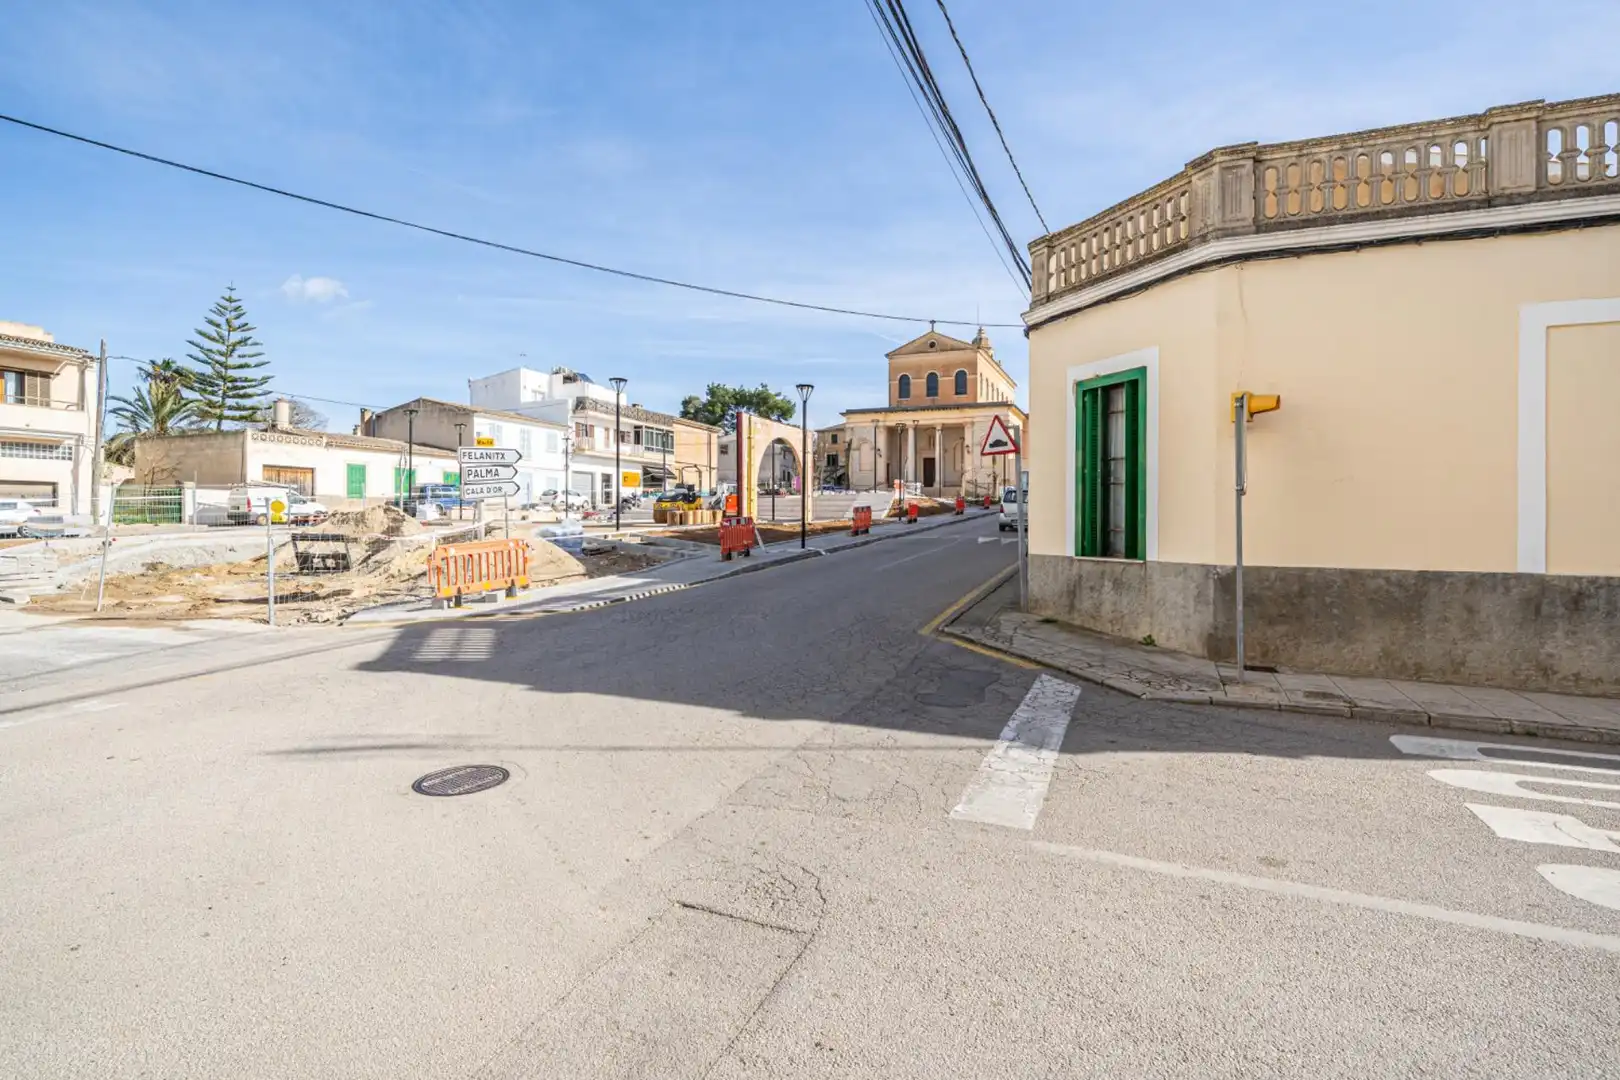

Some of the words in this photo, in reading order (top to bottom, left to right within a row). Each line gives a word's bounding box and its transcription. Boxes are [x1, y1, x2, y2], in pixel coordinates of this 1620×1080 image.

[462, 451, 506, 460] FELANITX
[467, 468, 500, 479] PALMA
[465, 487, 485, 495] CALA
[486, 486, 503, 494] D'OR
